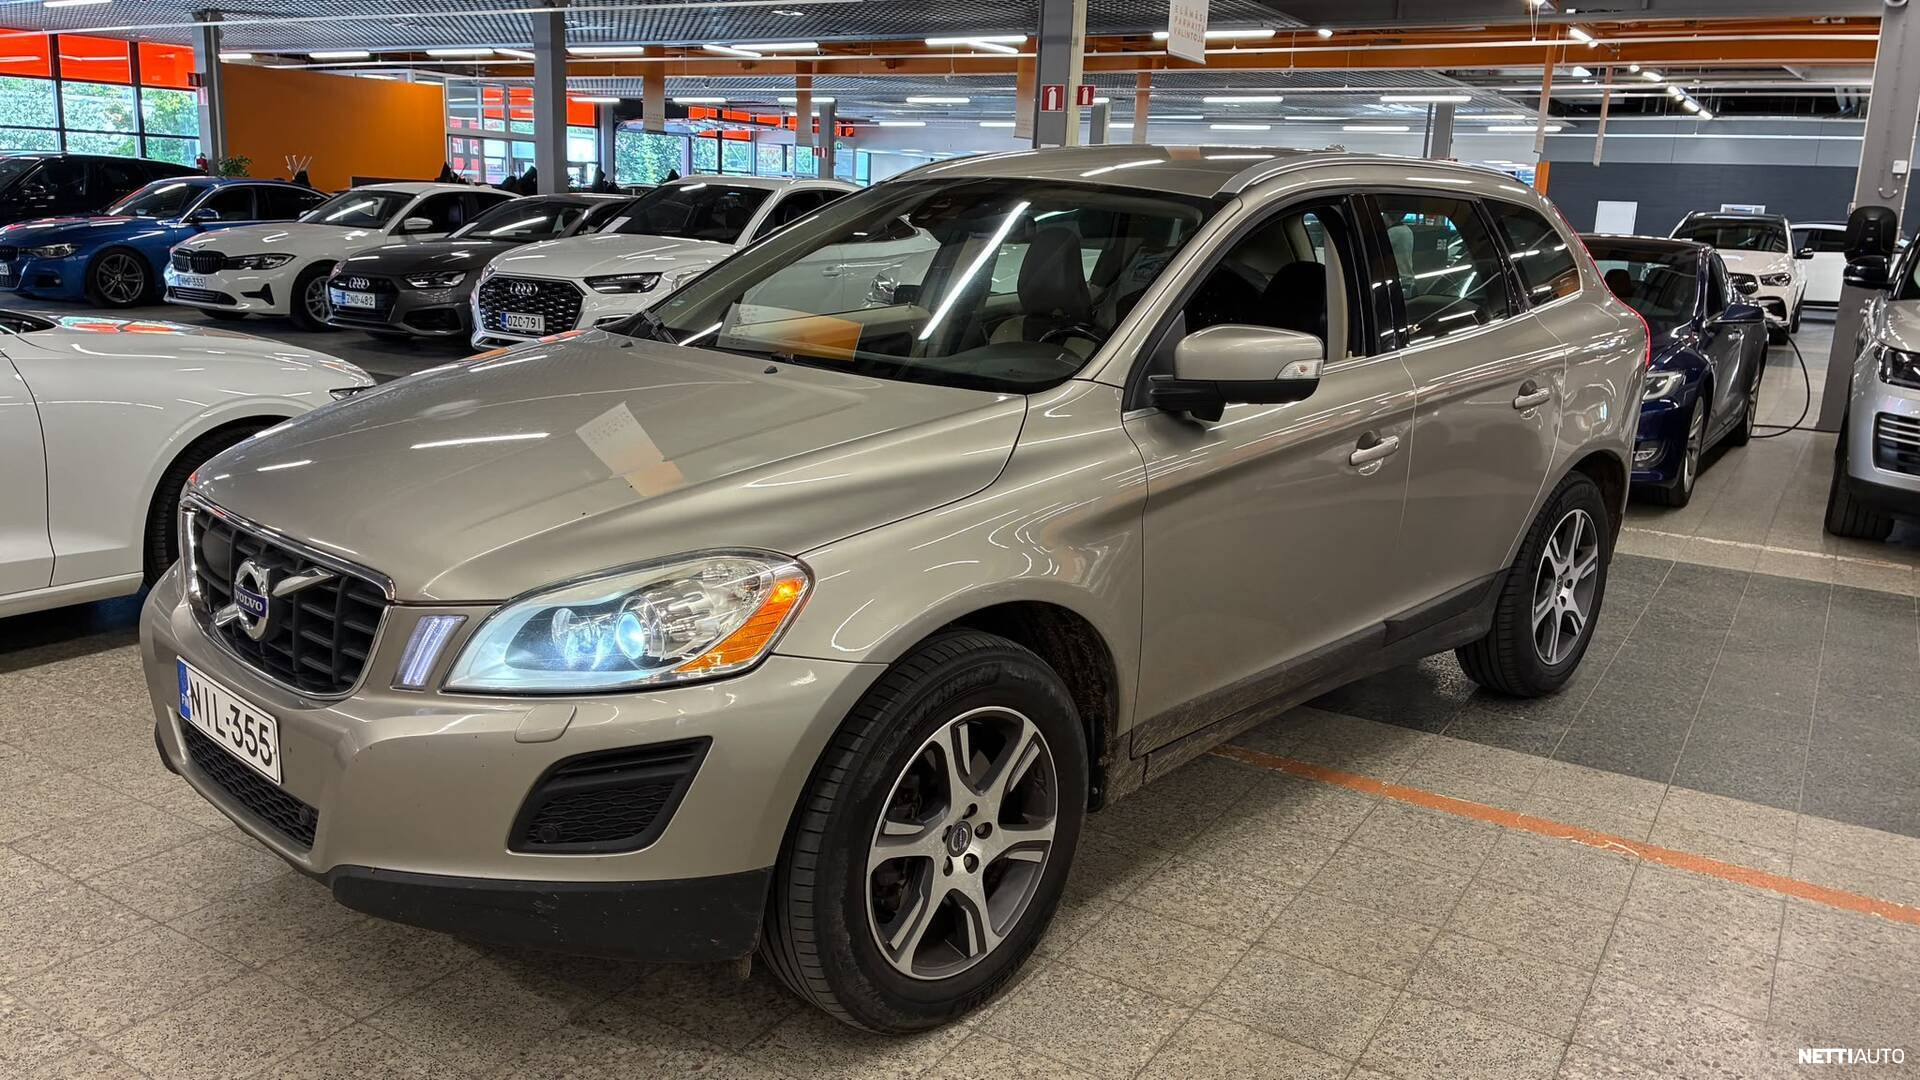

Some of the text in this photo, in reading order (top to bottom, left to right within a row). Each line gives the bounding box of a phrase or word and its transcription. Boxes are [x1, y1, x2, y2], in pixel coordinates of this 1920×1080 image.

[507, 315, 541, 330] OZC-791
[235, 589, 263, 612] VOLVO
[189, 676, 273, 767] NIL-355
